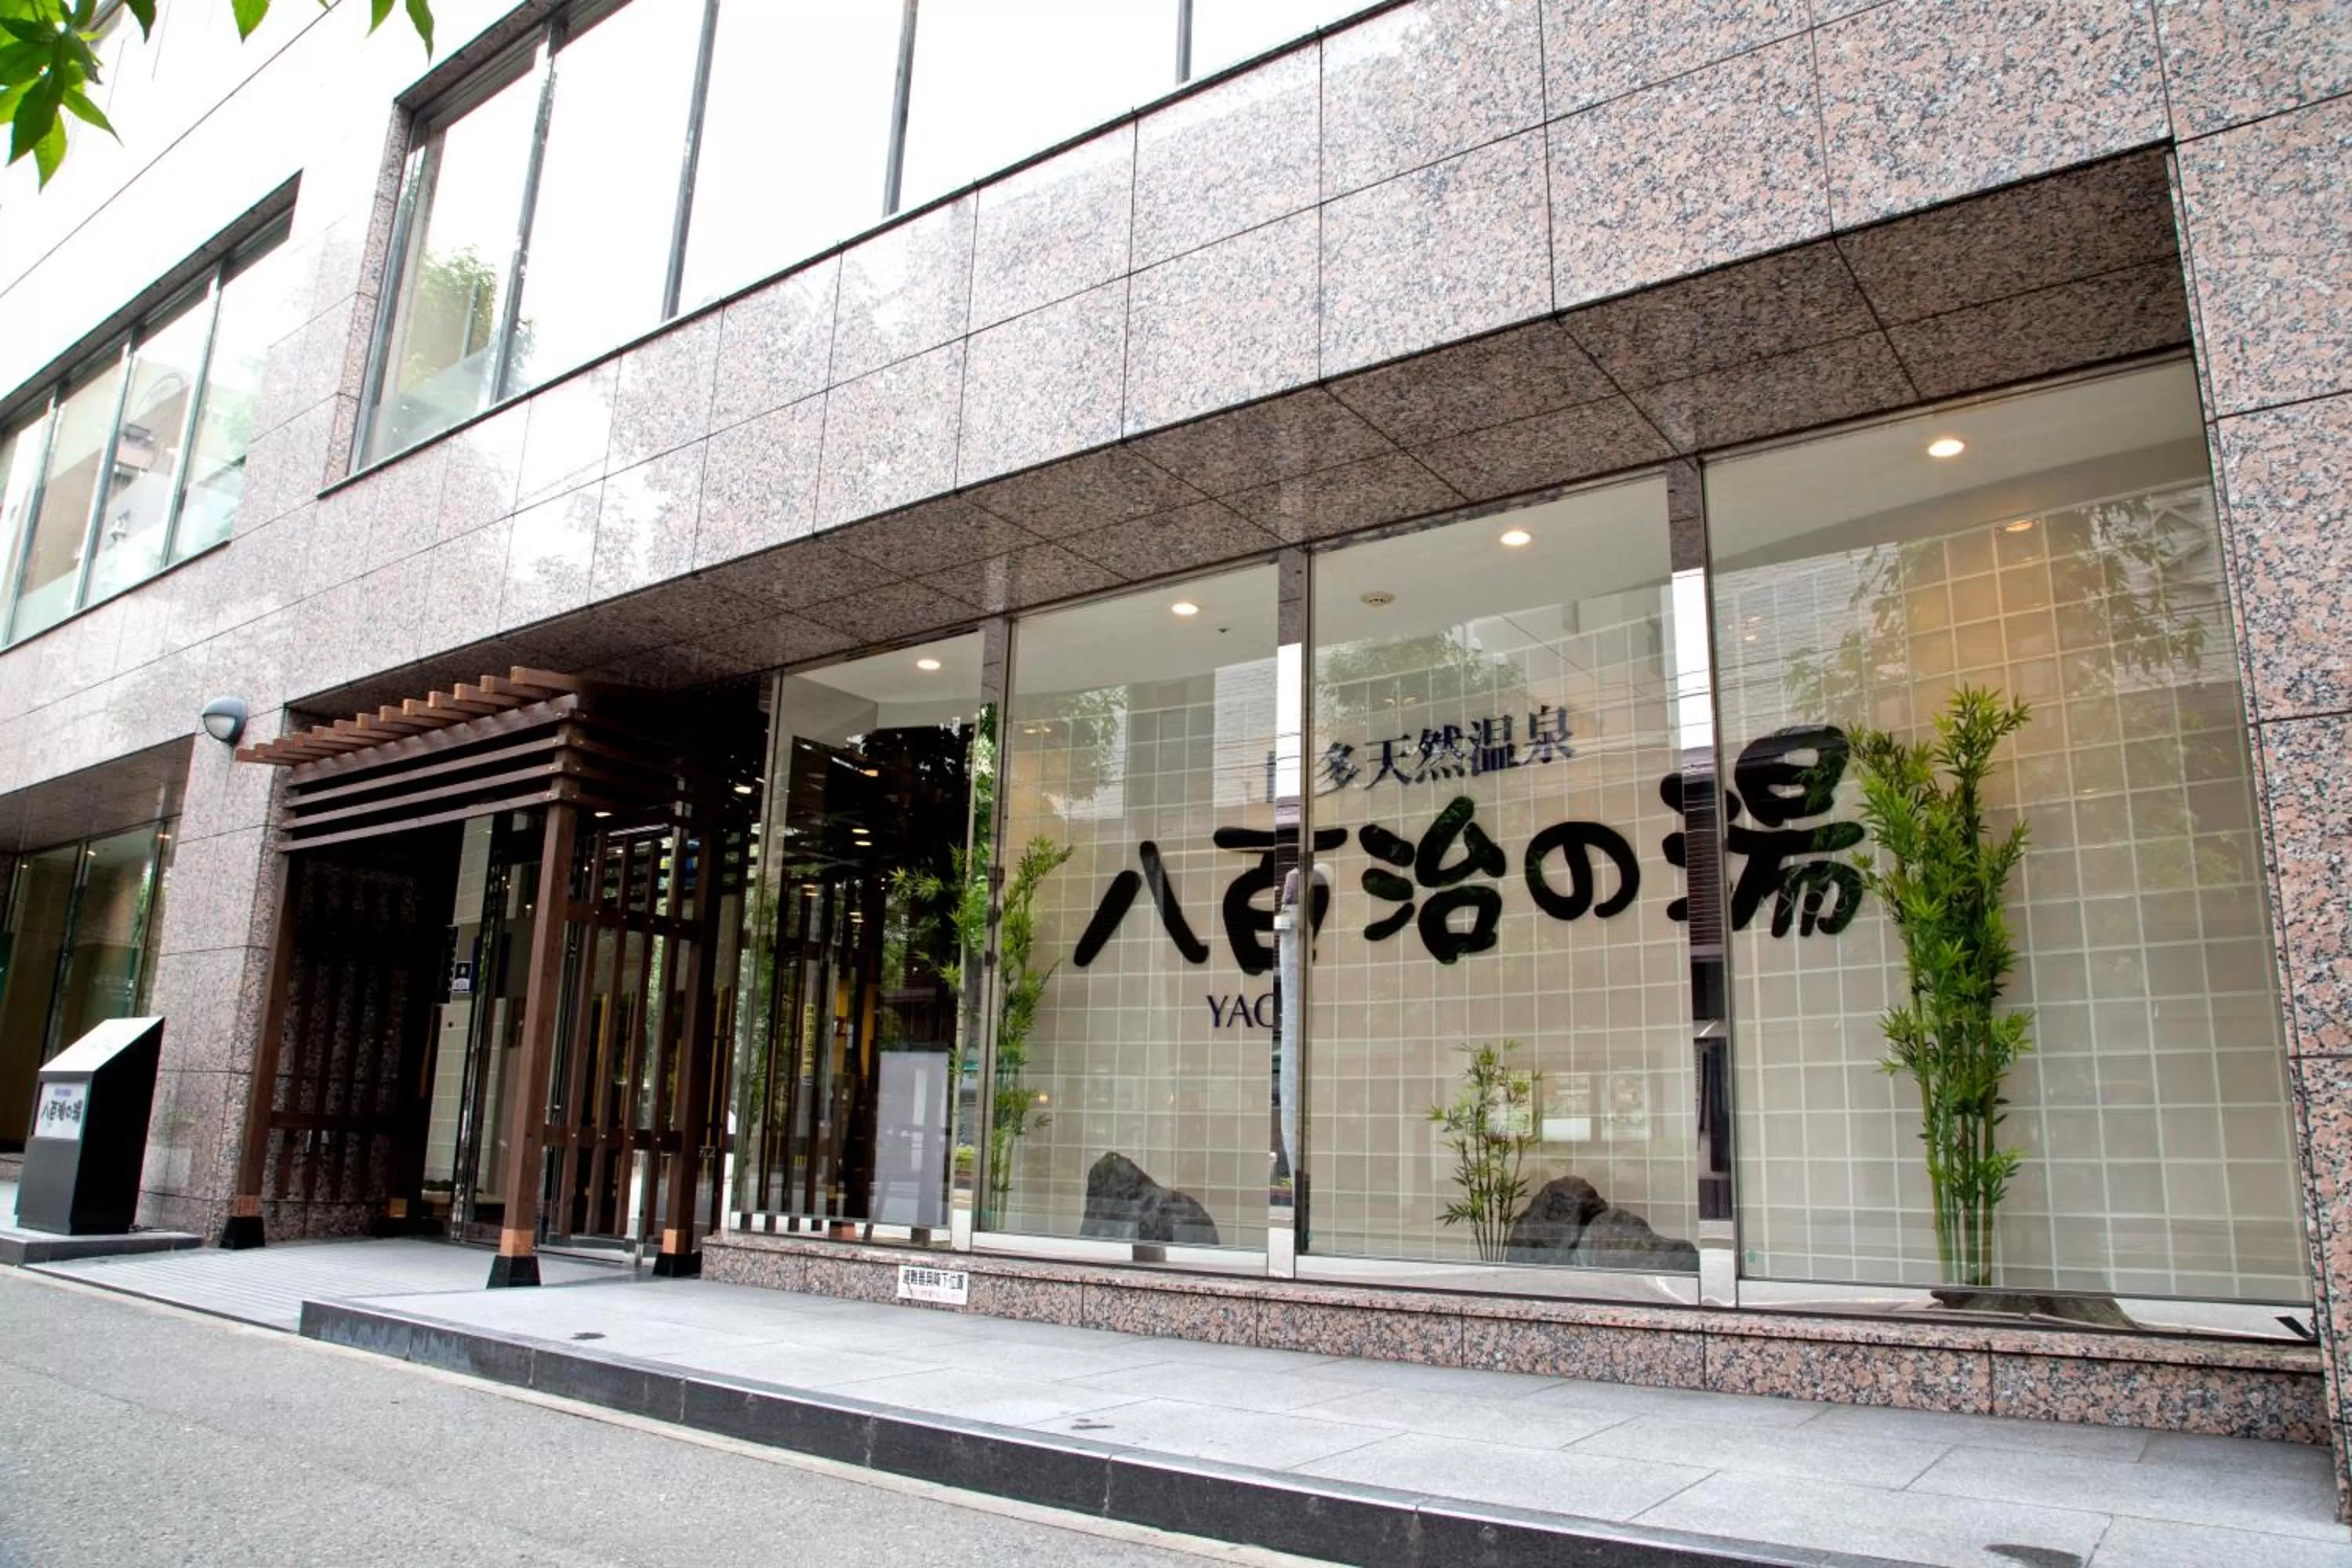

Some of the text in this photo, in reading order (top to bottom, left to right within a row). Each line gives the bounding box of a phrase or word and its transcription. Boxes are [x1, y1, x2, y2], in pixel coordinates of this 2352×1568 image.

[1266, 704, 1573, 802] 多天然温泉
[1073, 724, 1866, 977] 八百治の湯
